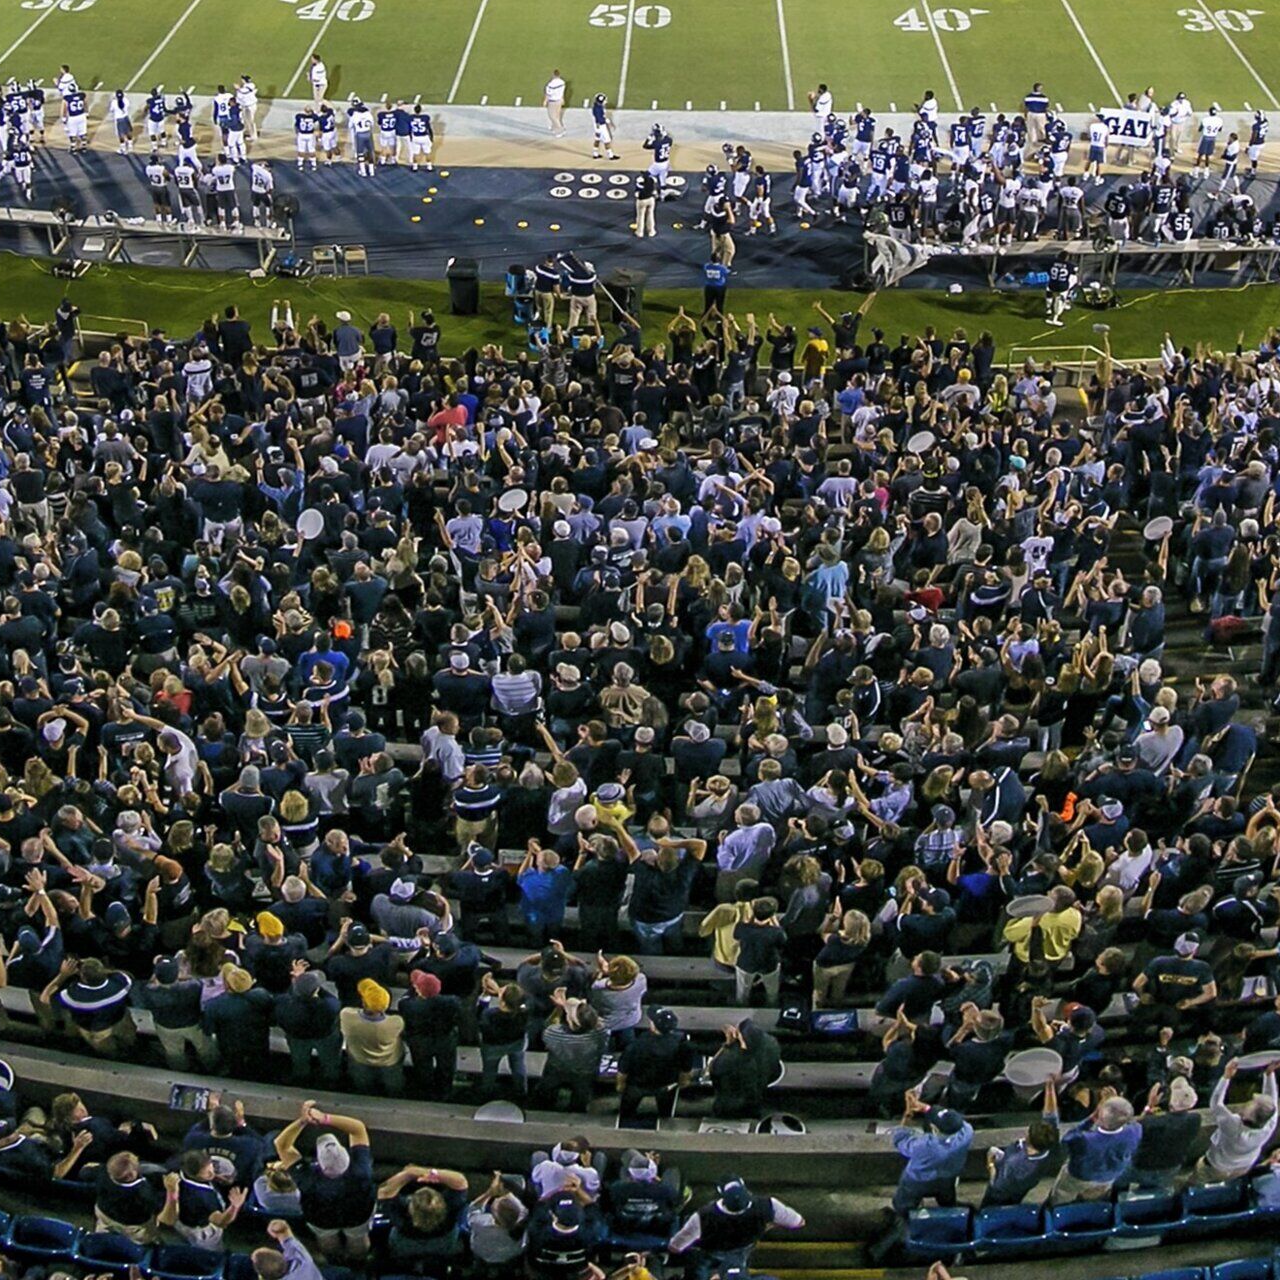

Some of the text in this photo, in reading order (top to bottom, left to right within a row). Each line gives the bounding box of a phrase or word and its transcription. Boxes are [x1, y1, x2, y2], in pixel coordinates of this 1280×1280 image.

[588, 4, 672, 29] 50
[893, 8, 971, 32] 40
[1176, 9, 1252, 32] 30
[70, 101, 85, 112] 60
[382, 118, 396, 129] 50
[411, 122, 426, 133] 55
[1107, 116, 1152, 139] GAT
[954, 131, 967, 143] 14
[1092, 131, 1102, 142] 91
[872, 159, 885, 171] 19
[555, 188, 566, 196] 10
[891, 211, 906, 222] 18
[1174, 217, 1190, 231] 56
[1050, 267, 1069, 281] 92
